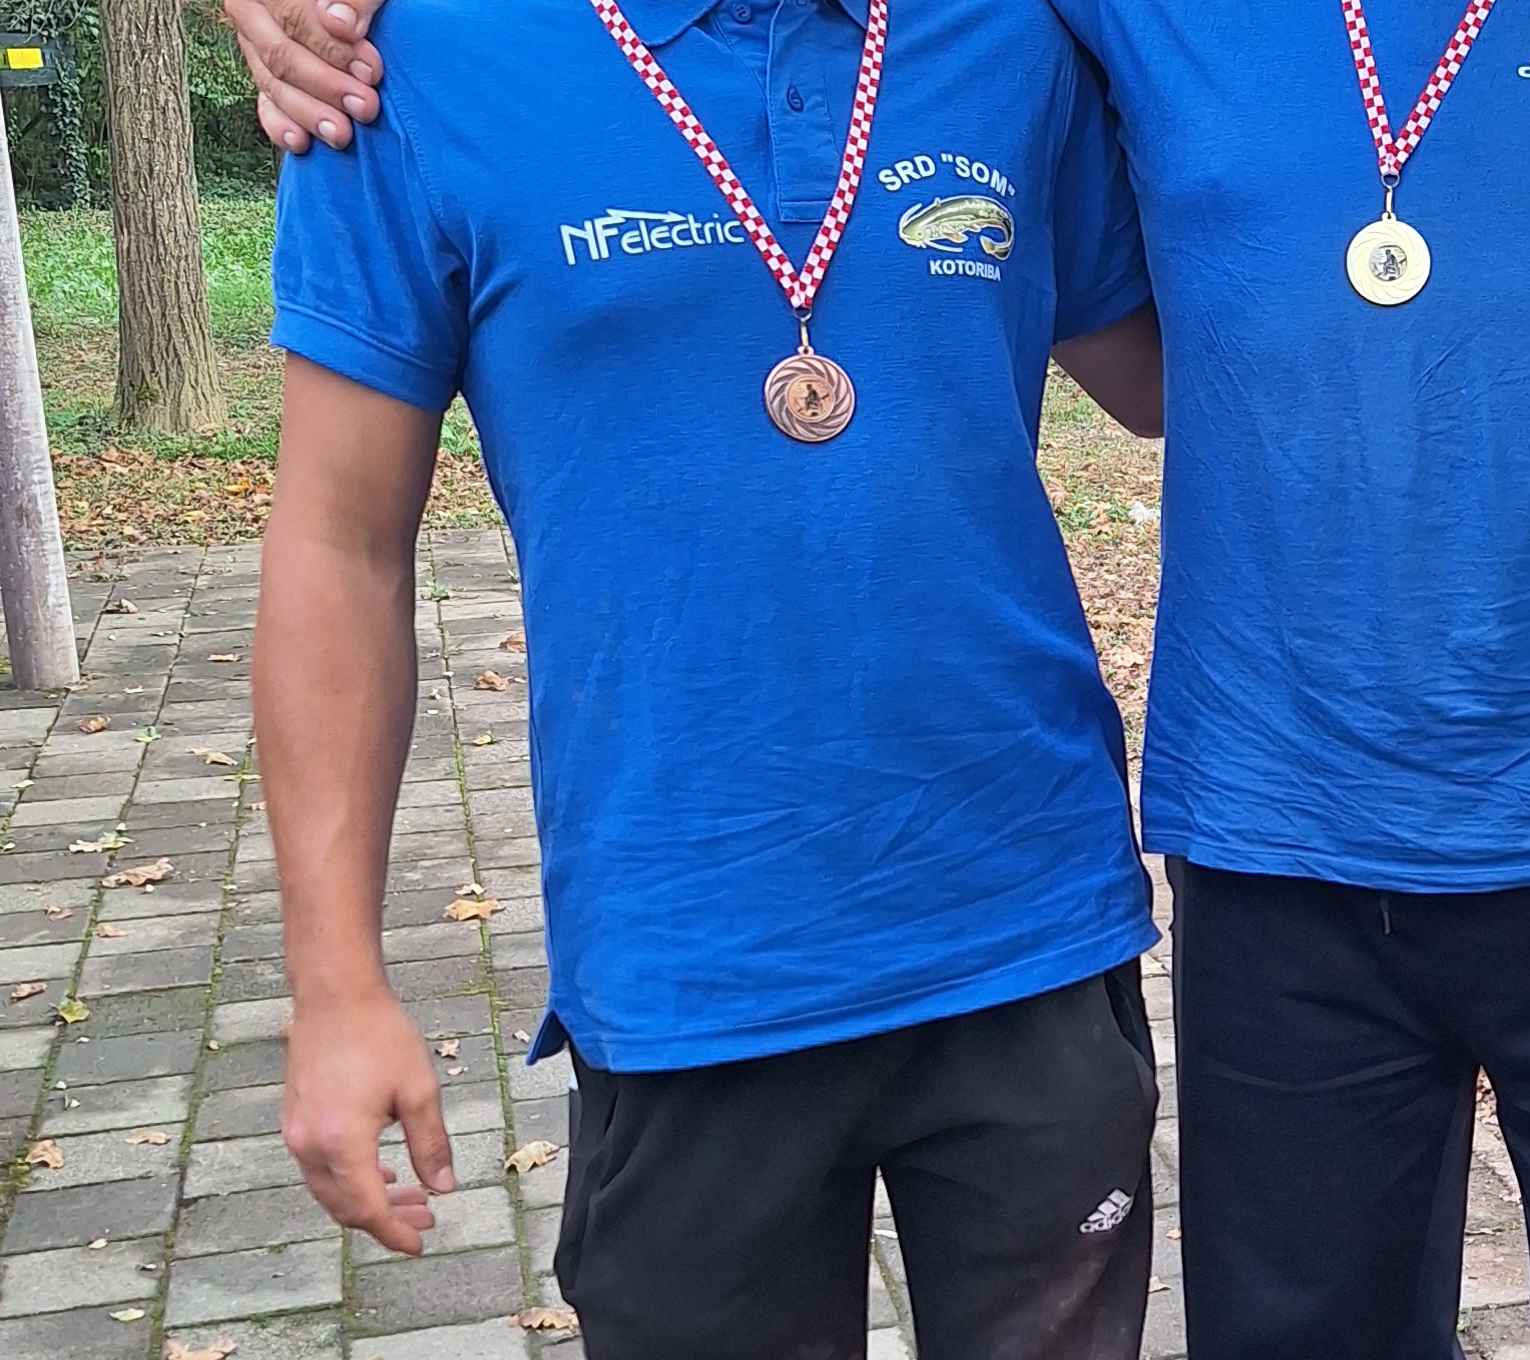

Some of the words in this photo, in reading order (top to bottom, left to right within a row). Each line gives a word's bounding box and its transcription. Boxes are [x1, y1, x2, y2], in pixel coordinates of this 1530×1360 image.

[878, 155, 936, 191] SRD
[941, 153, 1016, 197] "SOM"
[560, 213, 745, 266] NFelectric
[929, 259, 1001, 282] KOTORIBA
[1079, 1200, 1133, 1233] adida
